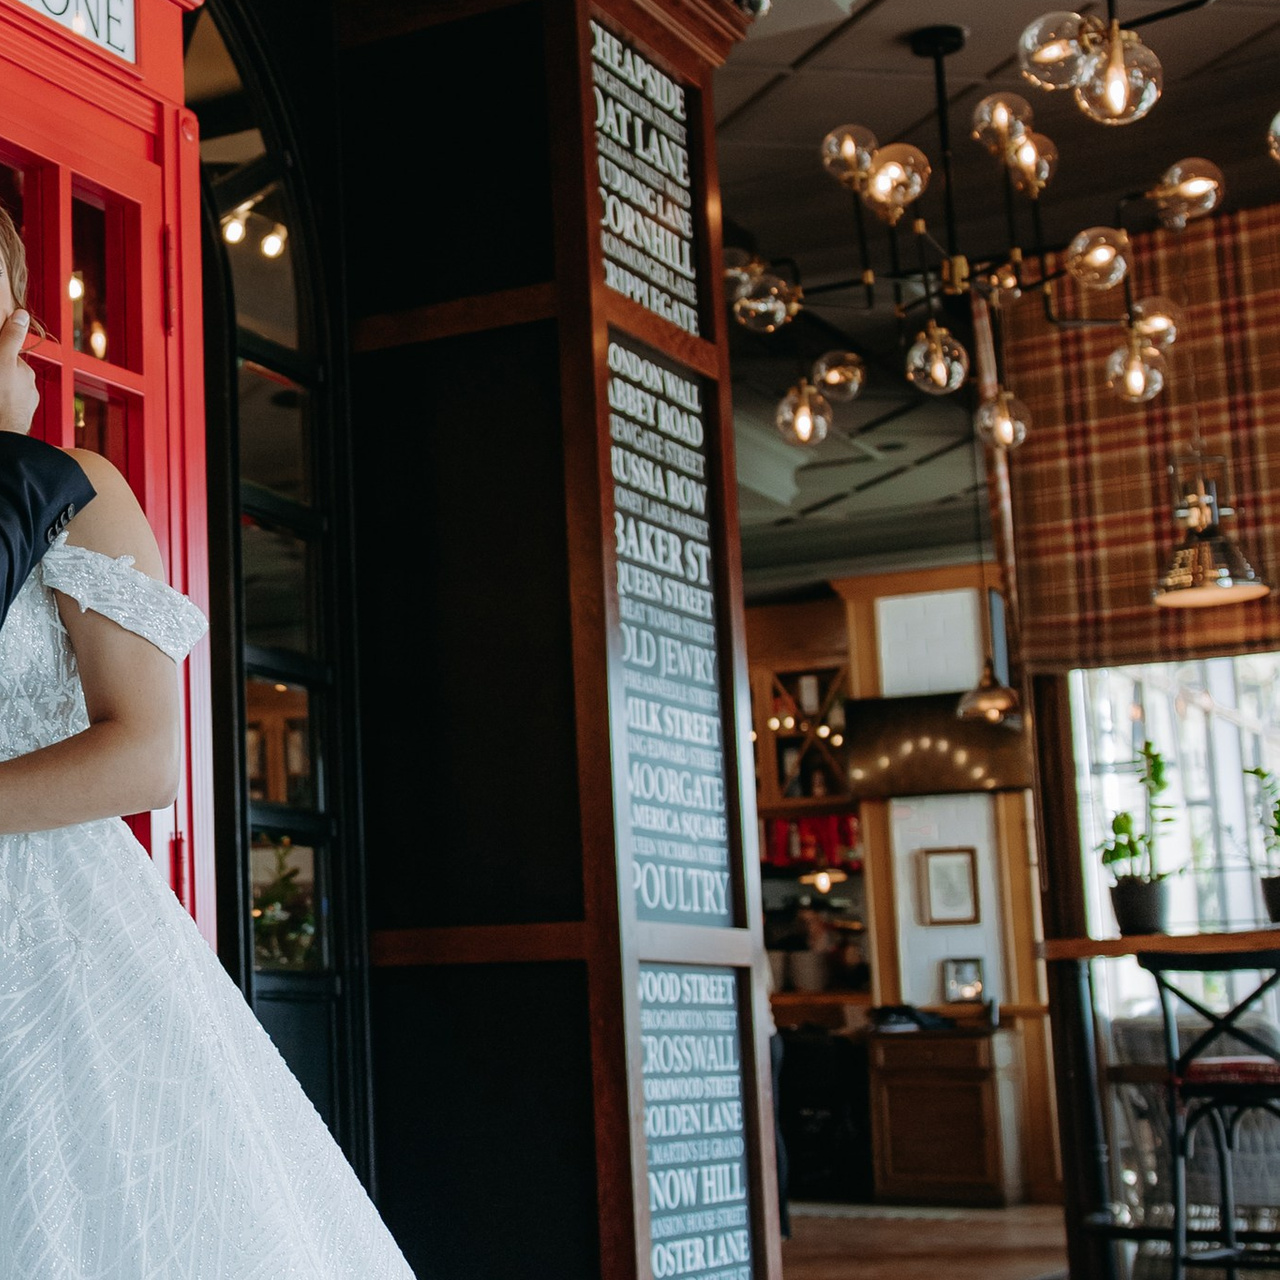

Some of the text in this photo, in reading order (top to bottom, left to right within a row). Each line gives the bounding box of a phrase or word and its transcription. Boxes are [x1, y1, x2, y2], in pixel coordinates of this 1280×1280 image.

[588, 18, 686, 123] HEAPSIDE
[633, 113, 690, 190] LANE
[597, 153, 693, 241] UDDING LANE
[598, 185, 696, 282] ORNHILL
[603, 257, 699, 338] RIPPLEGATE
[607, 339, 702, 415] ONDON WALL
[609, 411, 706, 481] EWGATE STREET
[656, 396, 704, 451] ROAD
[665, 467, 708, 517] ROW
[683, 536, 712, 588] ST
[661, 575, 714, 621] STREET
[657, 633, 718, 687] JEWRY
[661, 703, 721, 747] STREET
[630, 801, 681, 835] MERICA
[680, 972, 736, 1004] STREET
[643, 1075, 741, 1101] ORMWOOD STREET
[643, 1100, 743, 1138] OLDEN LANE
[647, 1161, 746, 1212] NOW HILL
[650, 1228, 750, 1279] OSTER LANE
